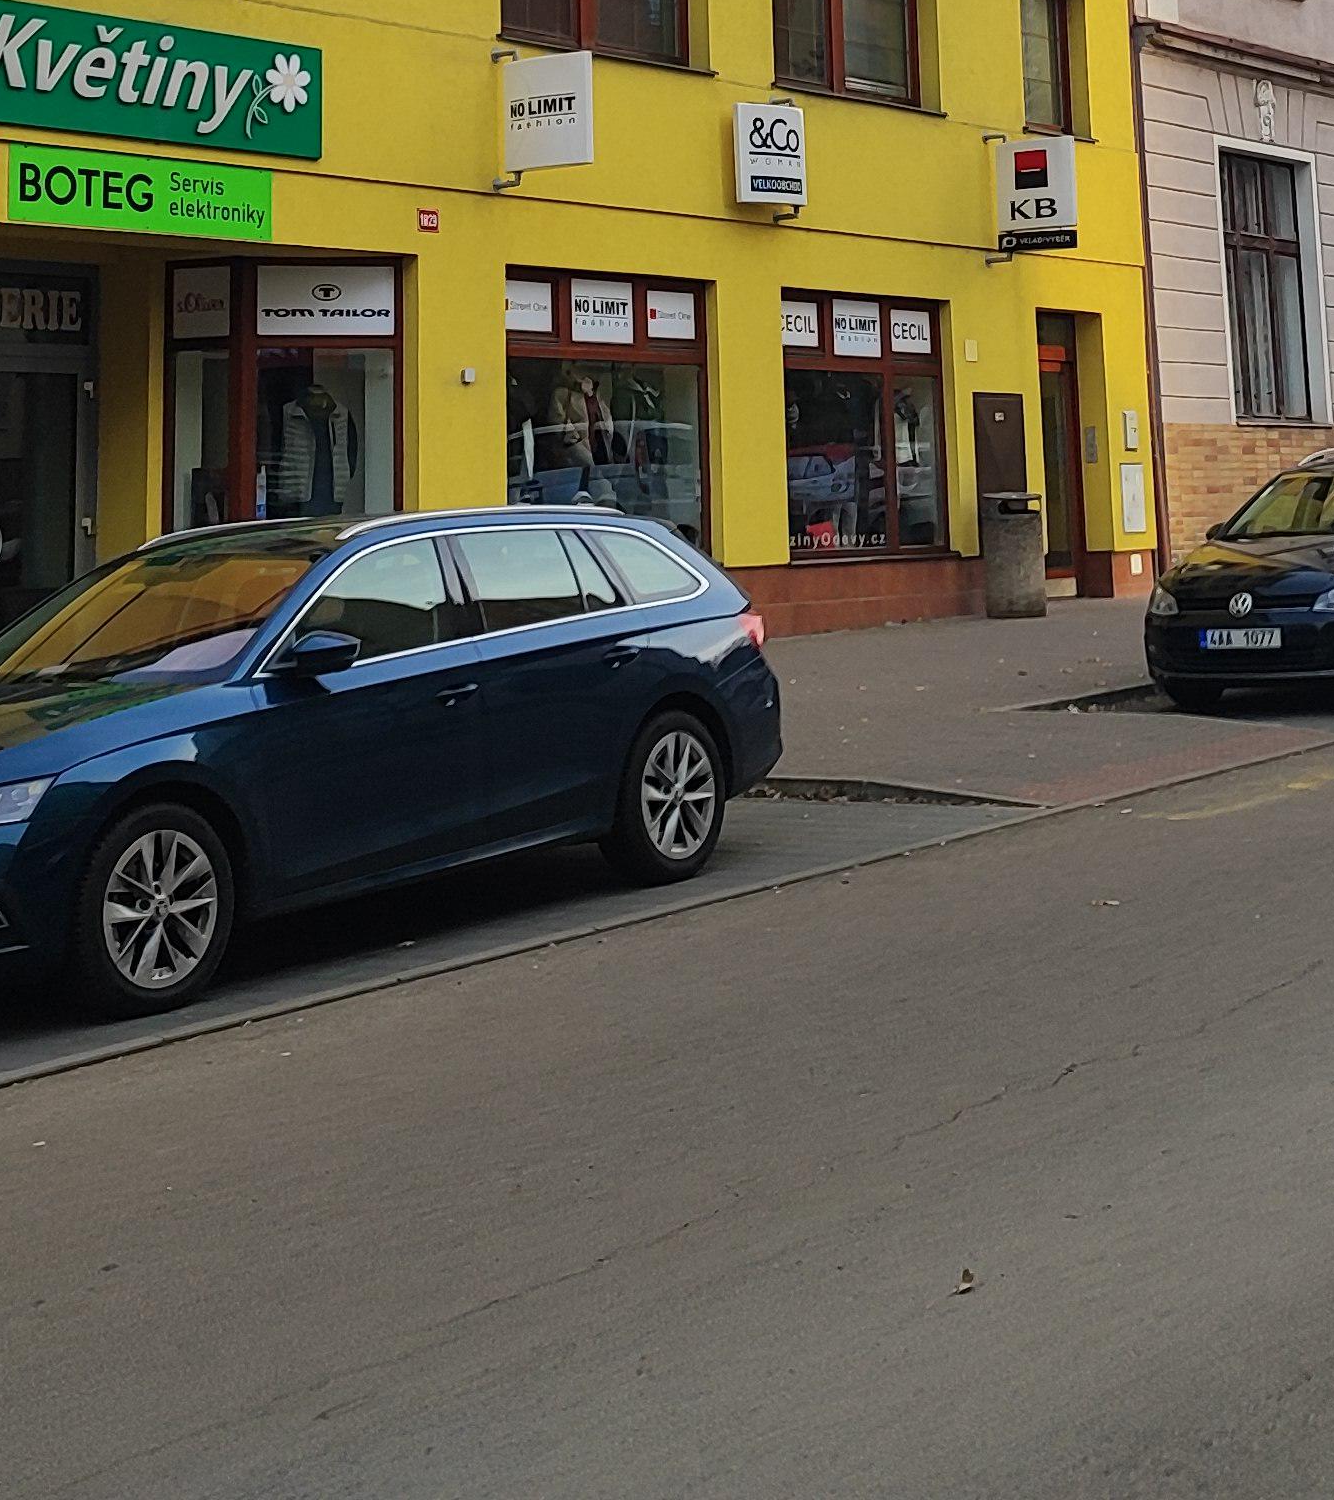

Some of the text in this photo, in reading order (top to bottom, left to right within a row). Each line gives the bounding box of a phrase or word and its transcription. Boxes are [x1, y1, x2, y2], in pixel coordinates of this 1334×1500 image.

[510, 96, 576, 119] NO LIMIT
[749, 117, 800, 153] &Co
[18, 162, 225, 213] BOTEG Servis
[169, 199, 266, 229] elektroniky
[1009, 197, 1058, 221] KB
[261, 308, 391, 318] TOM TAILOR
[574, 298, 628, 316] NO LIMIT
[834, 317, 878, 332] NO LIMIT
[892, 322, 928, 341] CECIL
